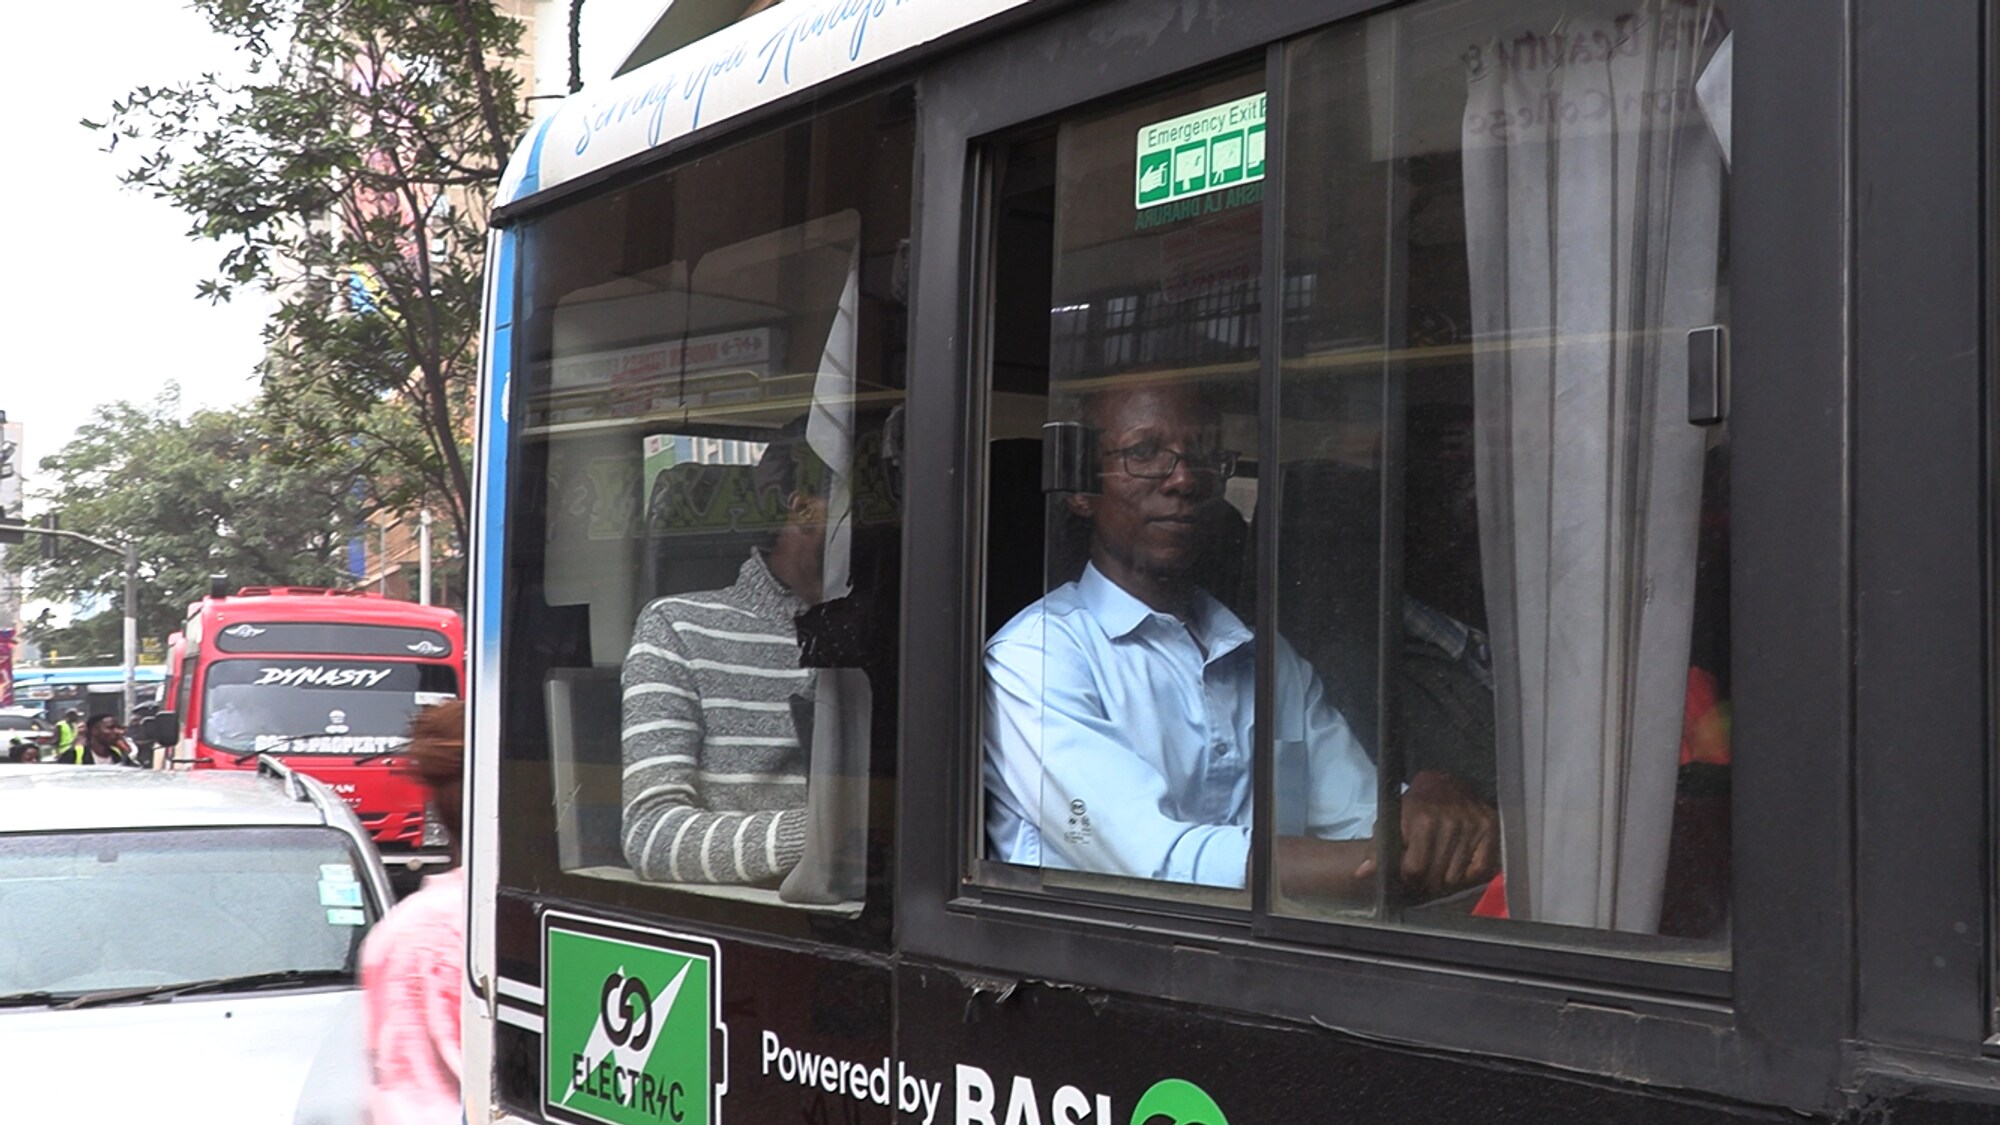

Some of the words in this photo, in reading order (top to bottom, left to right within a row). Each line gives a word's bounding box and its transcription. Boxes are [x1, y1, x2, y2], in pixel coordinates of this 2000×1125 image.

[1147, 113, 1226, 148] Emergency
[1229, 102, 1258, 126] Exit
[253, 666, 393, 687] DYNASTY
[762, 1030, 891, 1105] Powered
[897, 1061, 942, 1125] by
